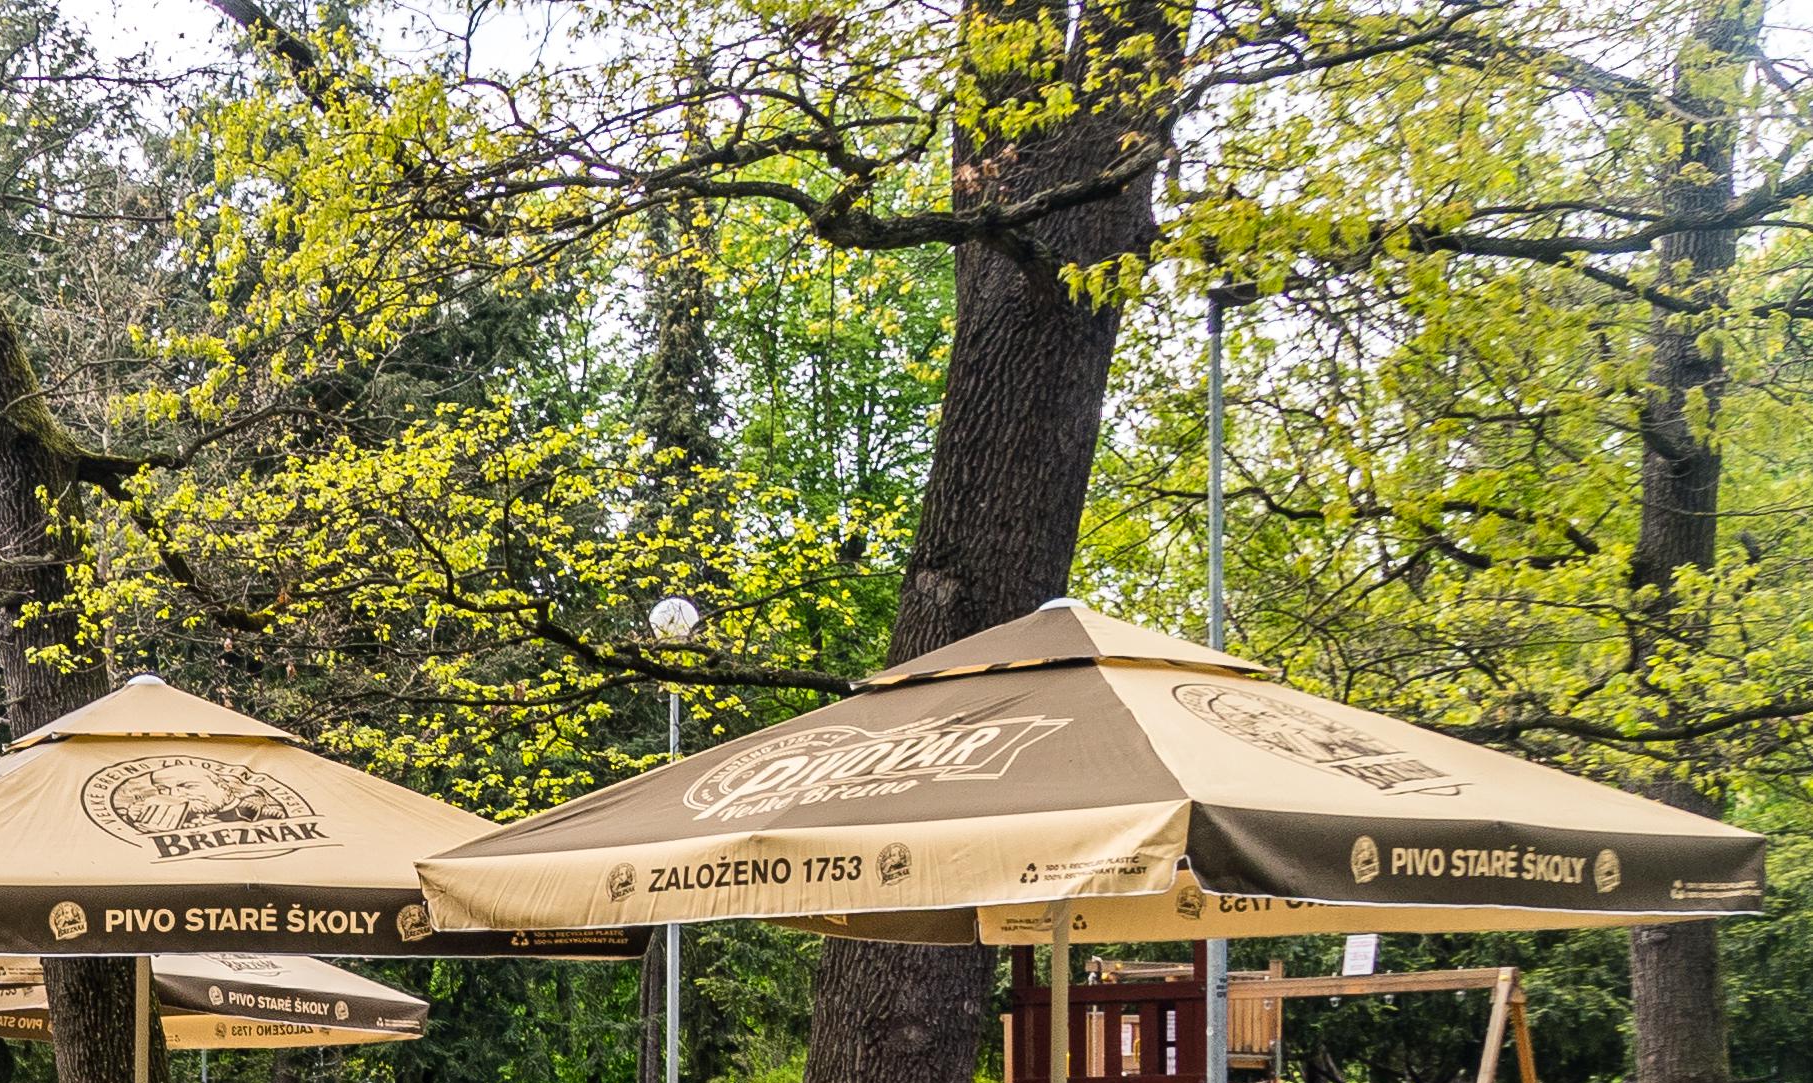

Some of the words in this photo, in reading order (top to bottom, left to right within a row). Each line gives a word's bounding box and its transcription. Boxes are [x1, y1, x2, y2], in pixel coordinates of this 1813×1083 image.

[693, 727, 1001, 820] PIVOVAR
[87, 793, 116, 824] VELKÉ
[151, 821, 330, 859] BŘEZNÁK
[648, 856, 792, 893] ZALOŽENO
[802, 855, 862, 883] 1753
[1119, 866, 1147, 875] PLAST
[1390, 847, 1445, 877] PIVO
[1450, 845, 1518, 878] STARÉ
[1521, 846, 1587, 884] ŠKOLY
[105, 908, 176, 933] PIVO
[185, 903, 277, 932] STARÉ
[286, 903, 381, 934] ŠKOLY
[228, 991, 256, 1008] PIVO
[257, 996, 292, 1013] STARÉ
[294, 996, 330, 1015] ŠKOLY
